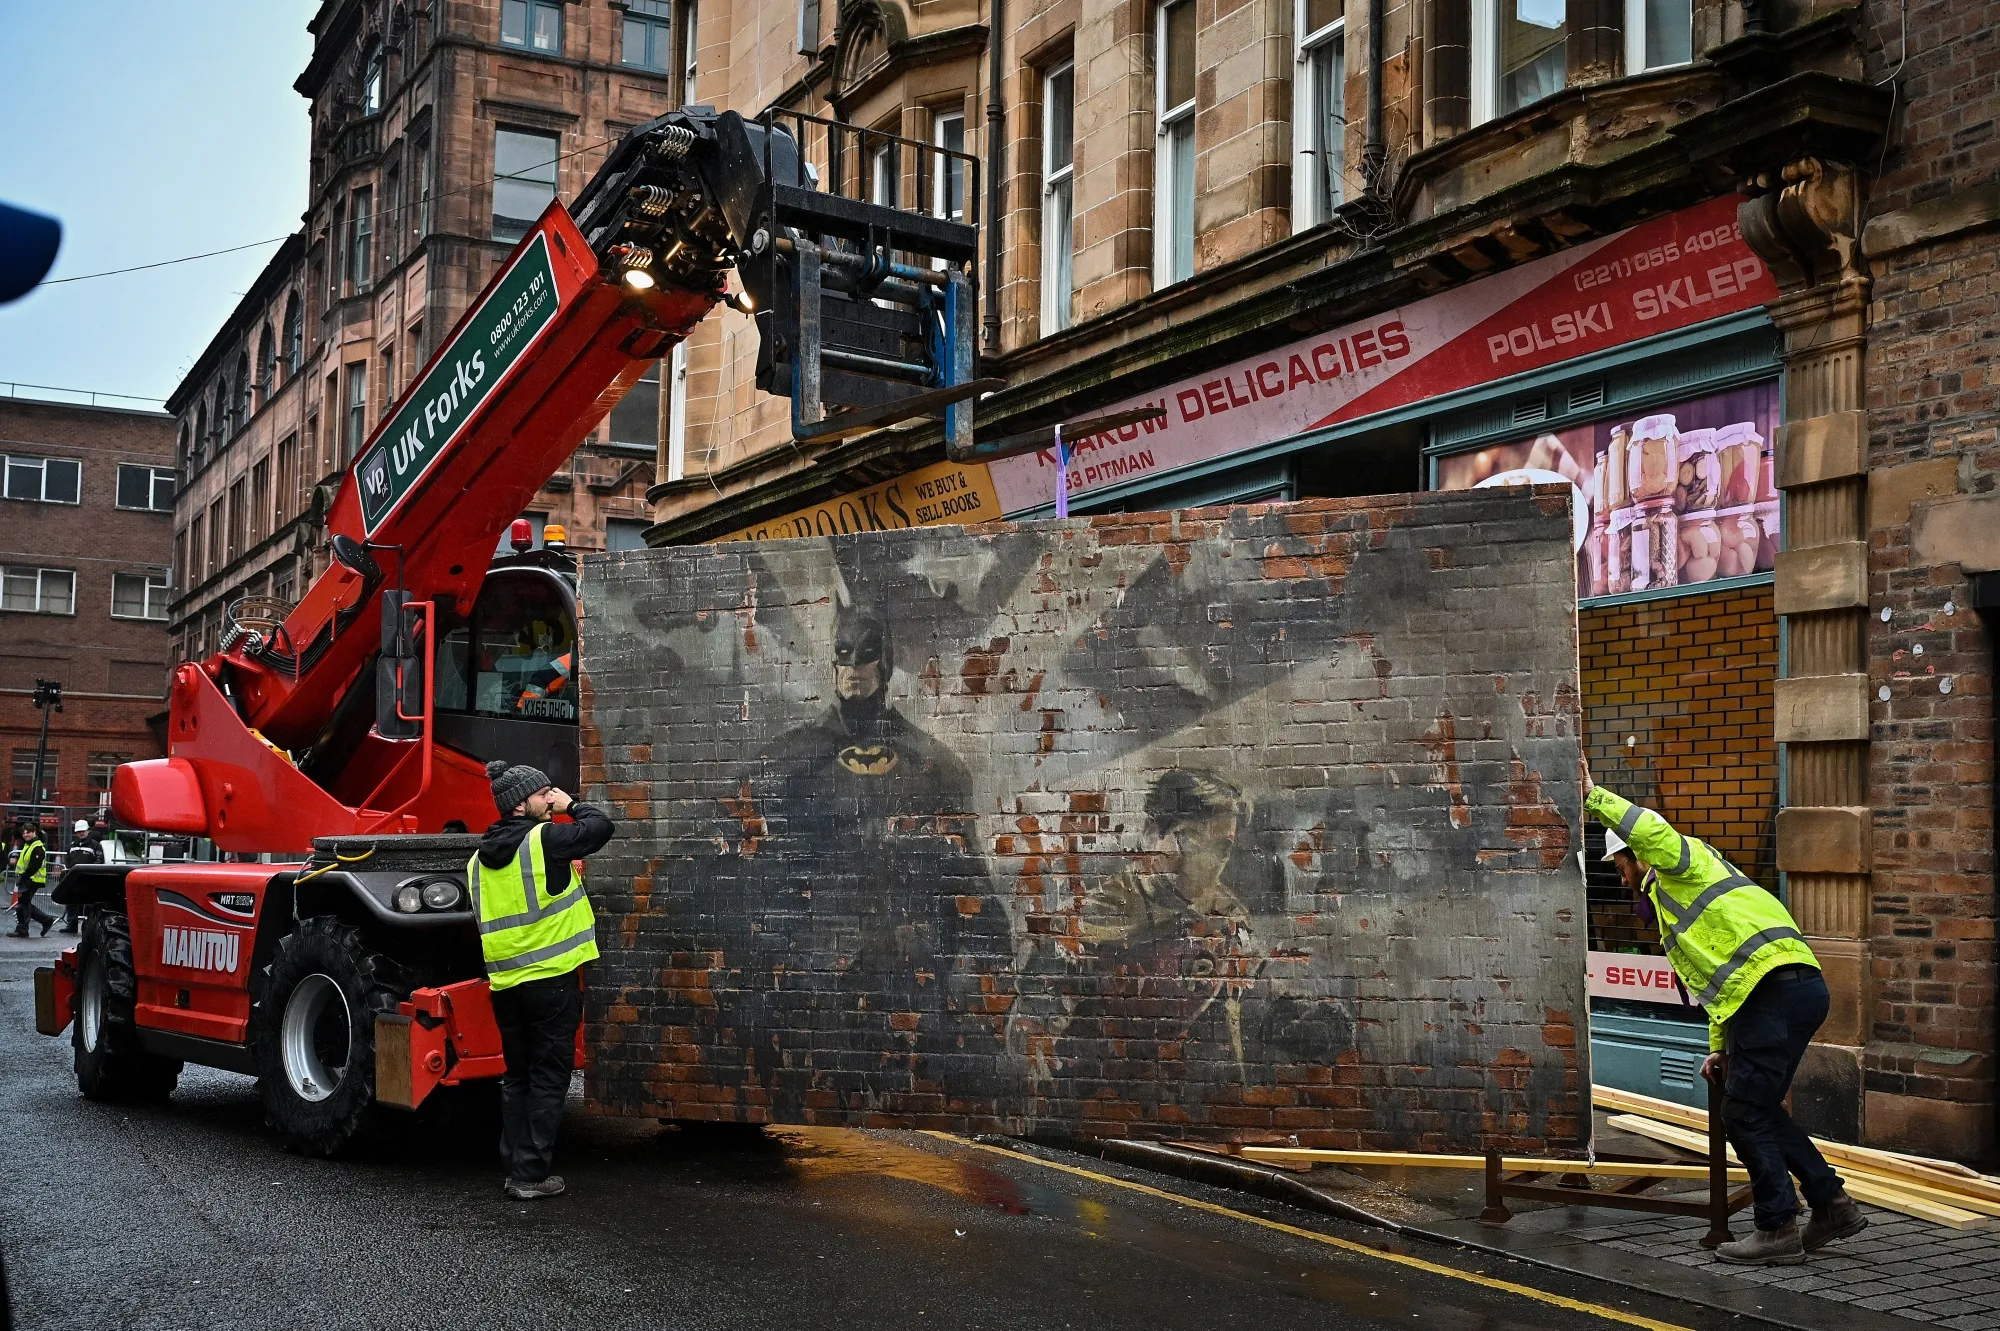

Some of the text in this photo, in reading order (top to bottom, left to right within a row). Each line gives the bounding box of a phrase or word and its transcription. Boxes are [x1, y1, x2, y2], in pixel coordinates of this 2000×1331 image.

[1574, 257, 1632, 292] (221)
[1634, 242, 1680, 272] 055
[490, 271, 545, 345] 0800 123 101
[493, 289, 548, 359] www.ukforks.com
[1487, 256, 1763, 363] POLSKI SKLEP
[1176, 320, 1411, 423] DELICACIES
[392, 348, 486, 476] UK Forks
[914, 470, 968, 501] WE BUY &
[1084, 450, 1156, 484] PITMAN
[915, 491, 981, 524] SELL BOOKS
[220, 894, 235, 905] MRT
[162, 925, 240, 973] MANITOU
